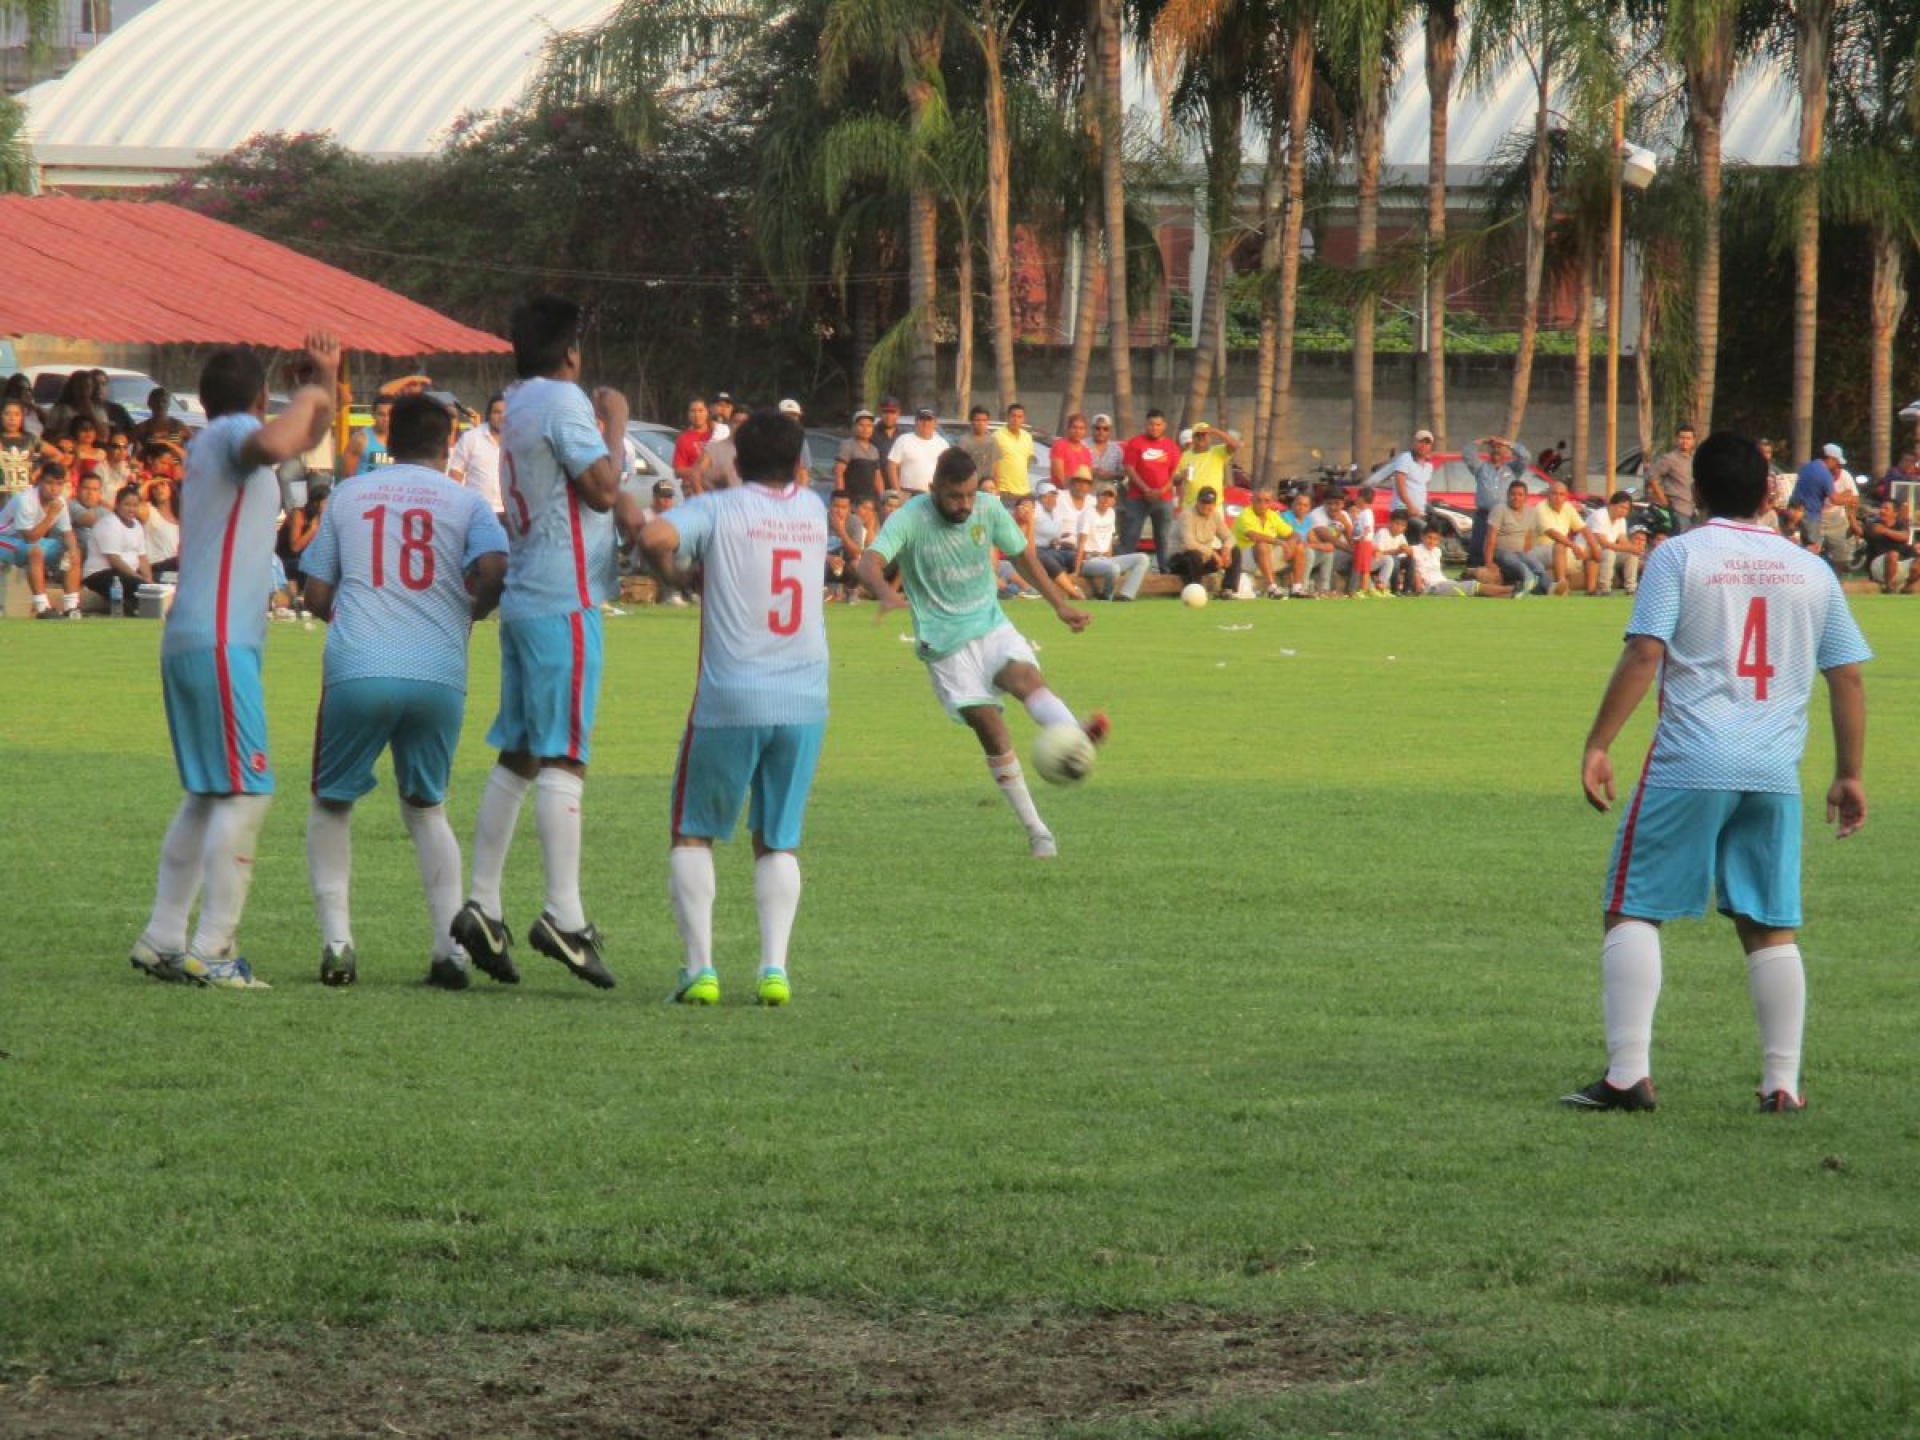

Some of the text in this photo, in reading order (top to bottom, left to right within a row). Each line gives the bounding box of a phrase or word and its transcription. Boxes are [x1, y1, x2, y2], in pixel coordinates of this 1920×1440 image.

[362, 503, 435, 591] 18
[1743, 574, 1756, 585] DE
[1759, 574, 1806, 585] EVENTOS
[767, 548, 803, 637] 5
[1736, 596, 1775, 701] 4
